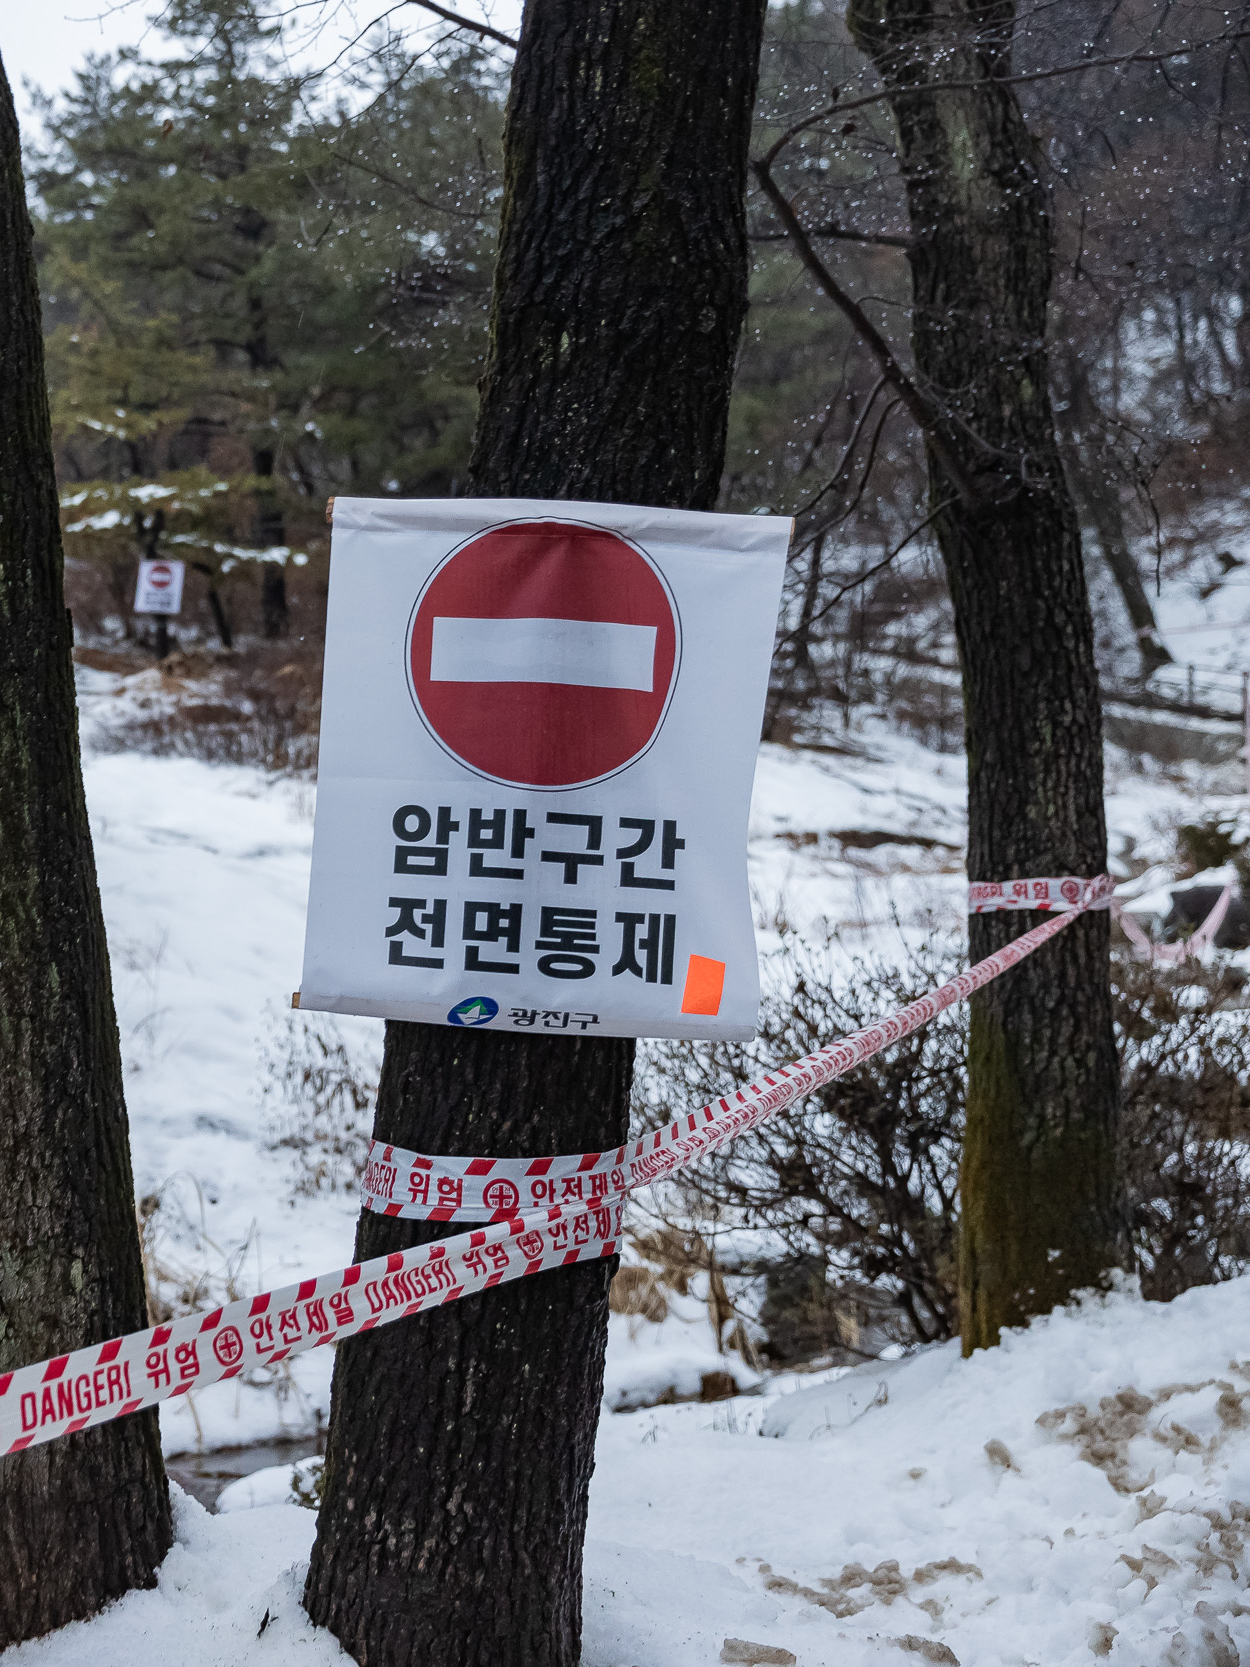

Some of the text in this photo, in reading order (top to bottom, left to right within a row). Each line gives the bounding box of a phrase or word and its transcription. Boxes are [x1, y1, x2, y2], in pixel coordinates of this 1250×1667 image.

[392, 804, 686, 891] 암반구간
[384, 896, 677, 985] 전면통제
[507, 1007, 600, 1030] 광진구
[145, 1338, 201, 1389] 위험
[250, 1289, 355, 1355] 안전제일
